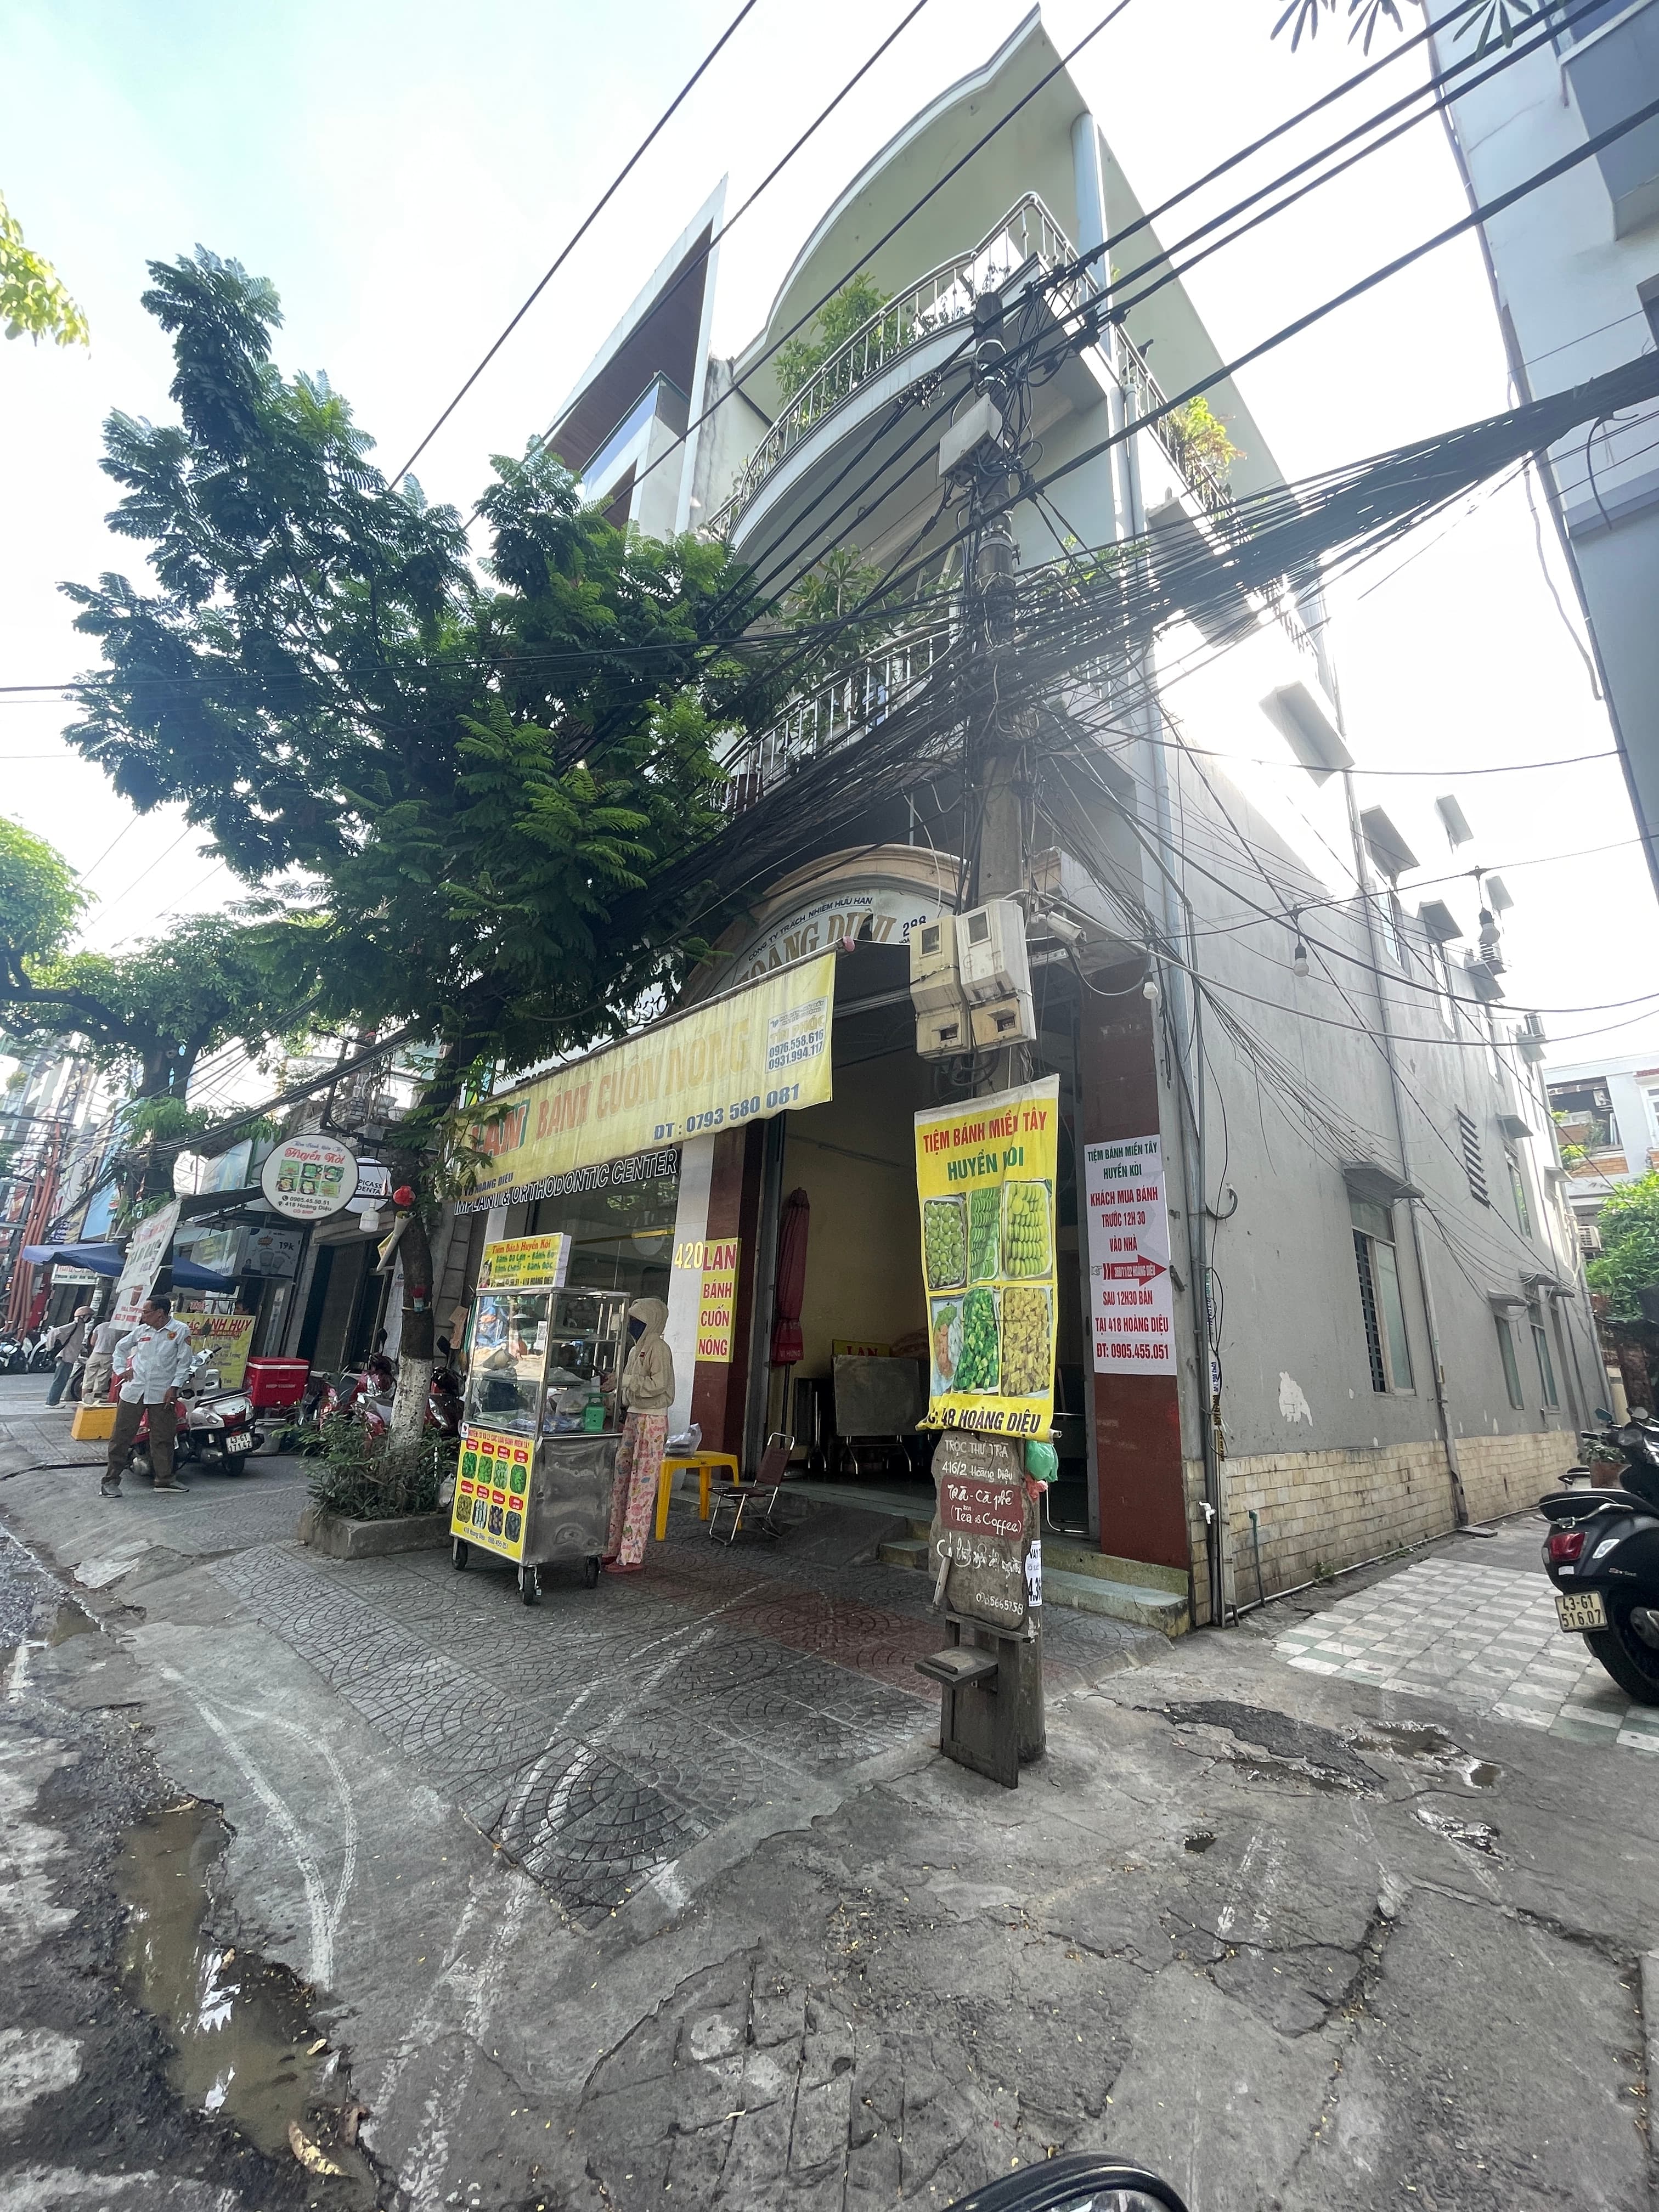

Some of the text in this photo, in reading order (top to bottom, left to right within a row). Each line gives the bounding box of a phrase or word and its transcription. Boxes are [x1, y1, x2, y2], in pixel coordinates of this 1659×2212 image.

[769, 932, 778, 943] TY
[769, 1029, 824, 1058] 0976.558.616
[768, 1041, 823, 1070] 0931.994.117
[686, 1107, 724, 1133] 0793
[729, 1096, 761, 1121] 580
[766, 1083, 800, 1109] 081
[923, 1128, 950, 1156] TIỆM
[953, 1122, 986, 1147] BÁNH
[1023, 1107, 1047, 1132] TÂY
[1087, 1148, 1104, 1164] TIỆM
[1144, 1140, 1158, 1154] TÂY
[358, 1178, 383, 1189] PICASS
[512, 1163, 610, 1204] ORTHODONTIC
[611, 1148, 679, 1185] CENTER
[357, 1185, 381, 1195] DENTA
[1090, 1184, 1159, 1207] KHÁCH MUA BÁNH
[1101, 1210, 1146, 1228] TRƯỚC 12H 30
[1109, 1233, 1138, 1252] VÀO NHÀ
[674, 1240, 704, 1269] 420
[703, 1244, 737, 1271] LAN
[703, 1278, 732, 1299] BÁNH
[1103, 1286, 1154, 1306] SAU 12H30 BÁN
[229, 1319, 252, 1332] HUY
[700, 1304, 730, 1327] CUỐN
[1094, 1313, 1169, 1336] TẠI 418 HOÀNG DIỆU
[698, 1334, 728, 1356] NÓNG
[1096, 1342, 1170, 1359] ĐT: 0905.455.051
[958, 1406, 1005, 1431] HOÀNG
[1006, 1409, 1041, 1437] DIỆU
[941, 1460, 968, 1477] 416/2
[1029, 1549, 1039, 1559] VAY
[1562, 1594, 1594, 1612] 43-G1
[1560, 1609, 1601, 1628] 516.07
